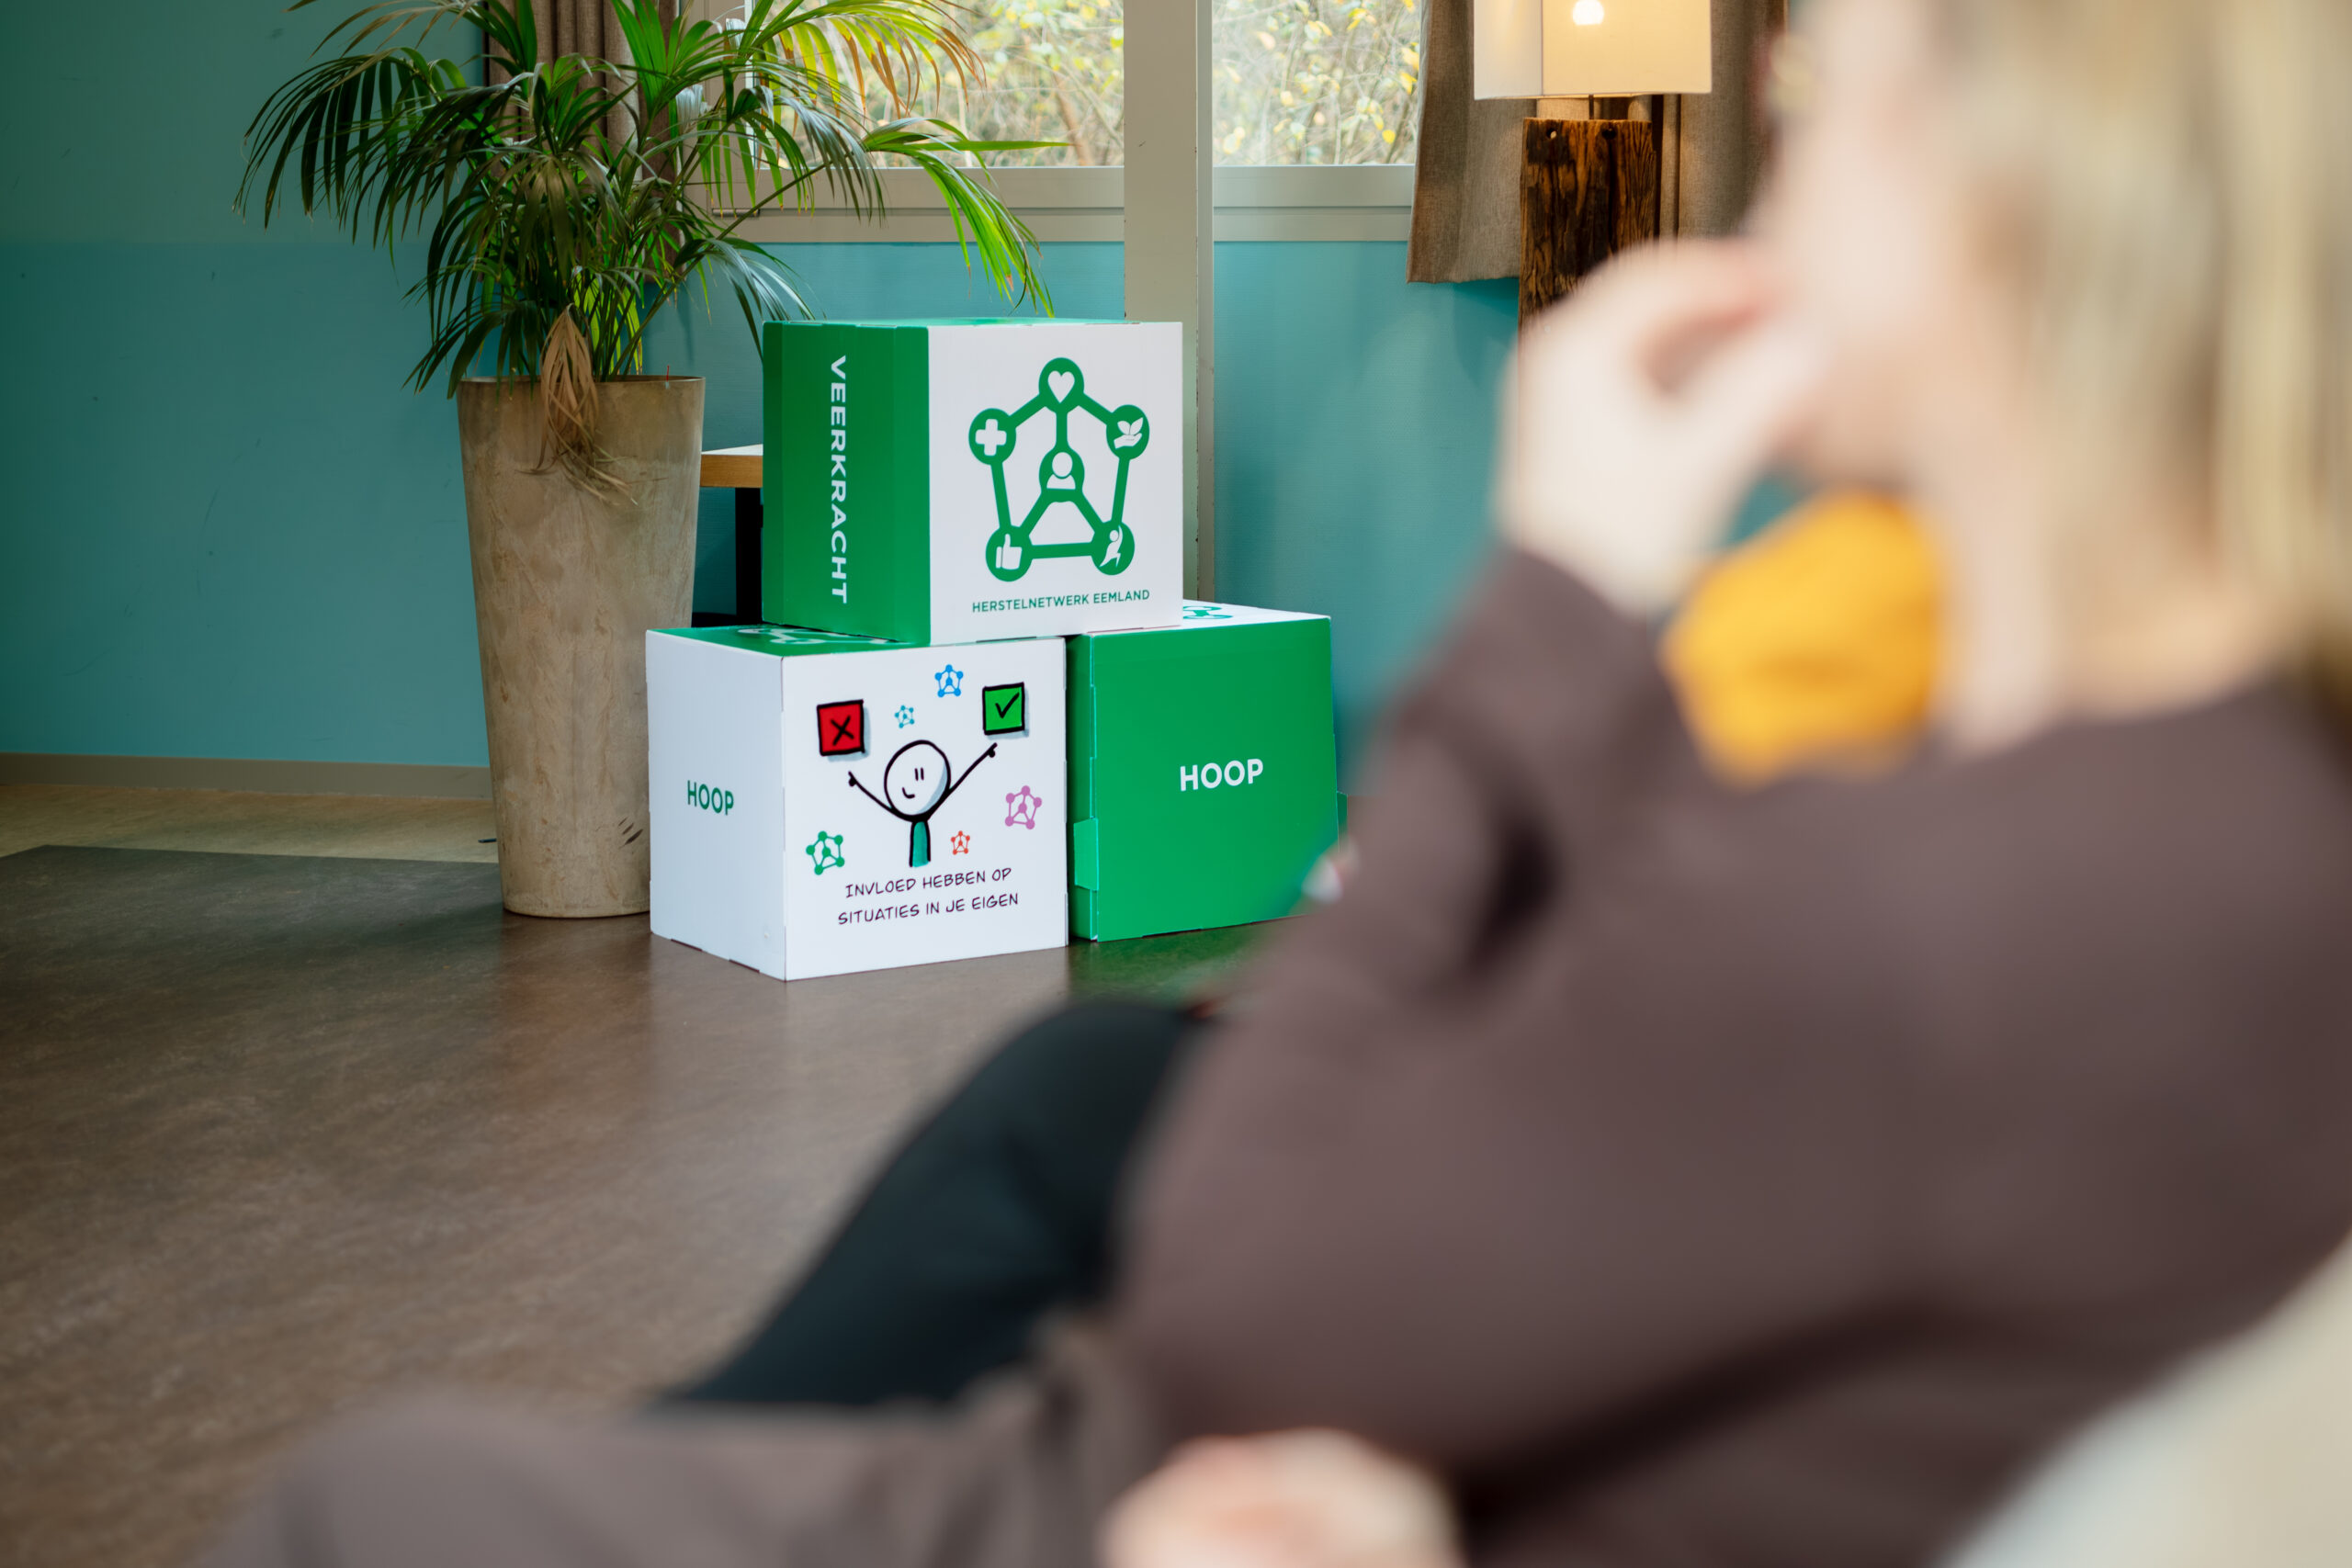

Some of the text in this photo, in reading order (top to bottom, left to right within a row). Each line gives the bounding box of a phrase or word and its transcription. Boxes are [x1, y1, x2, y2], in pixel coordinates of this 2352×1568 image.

[831, 355, 847, 604] VEERKRACHT
[972, 589, 1150, 613] HERSTELNETWERK EEMLAND
[1180, 758, 1264, 792] HOOP
[687, 780, 734, 816] HOOP
[845, 867, 1012, 898] INVLOED HEBBEN OP
[838, 893, 1018, 925] SITUATIES IN JE EIGEN
